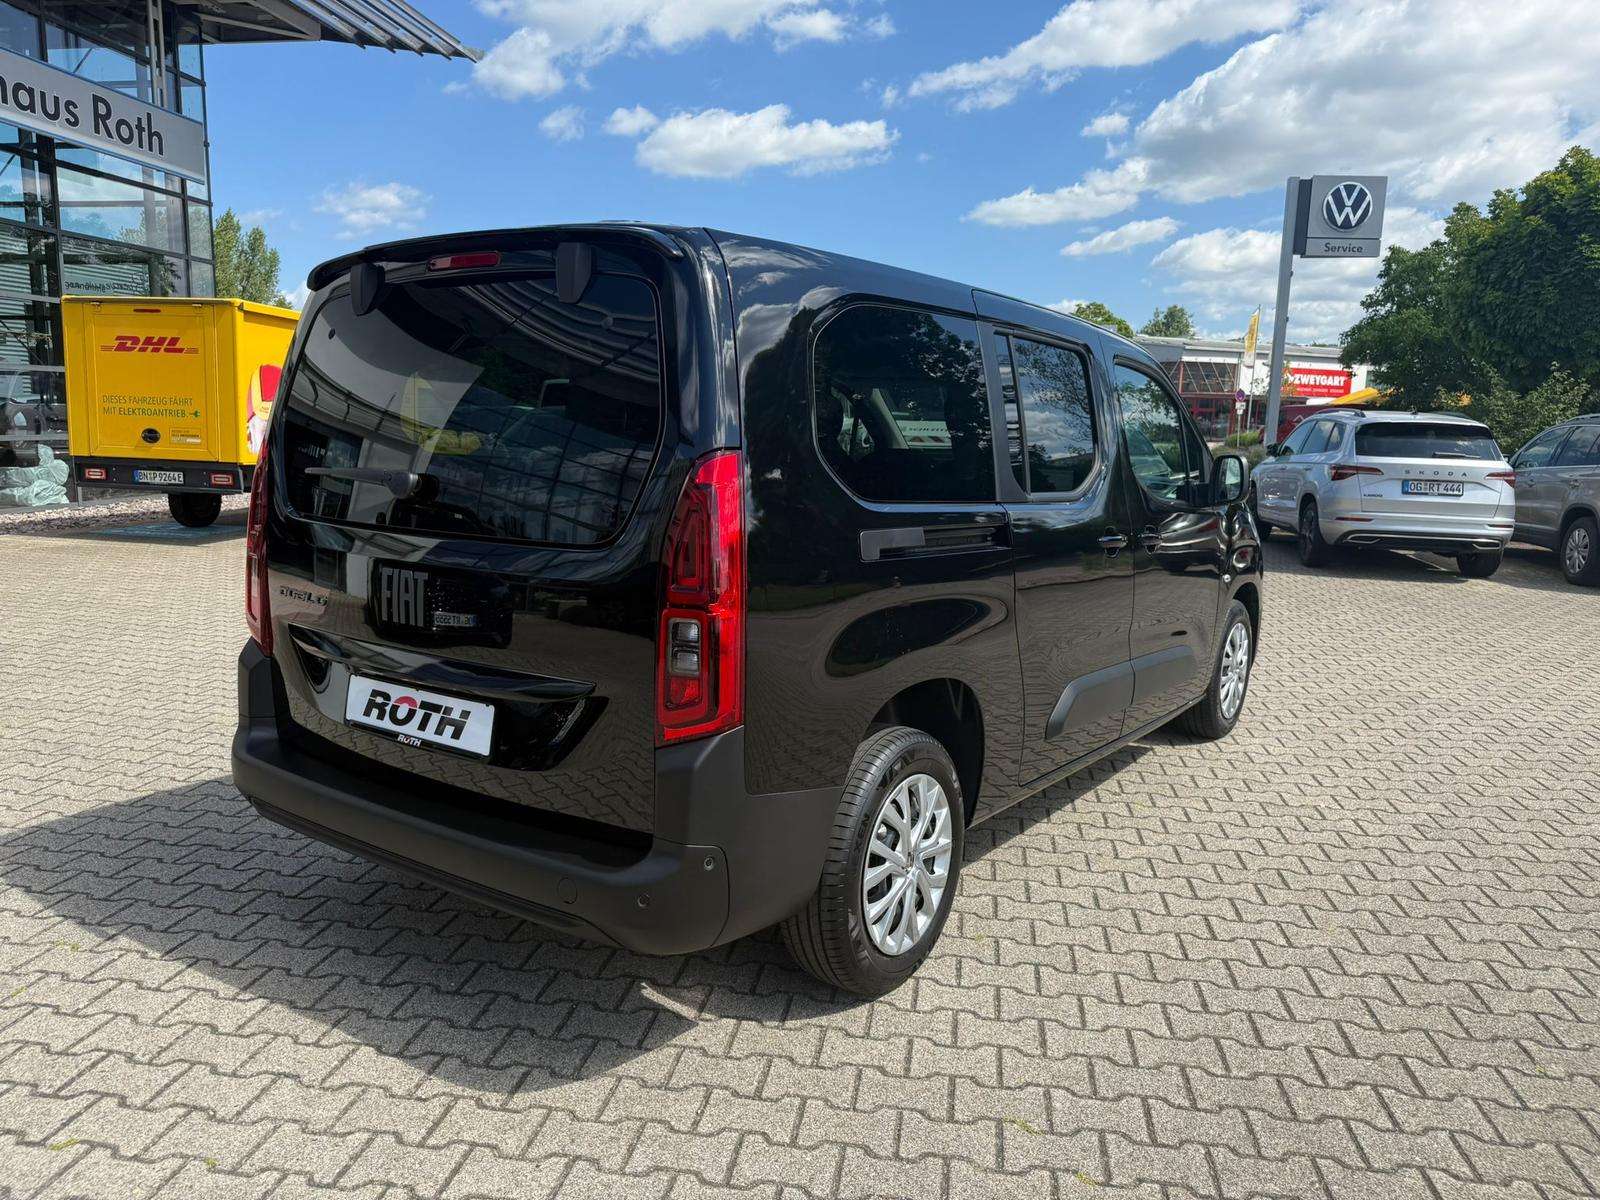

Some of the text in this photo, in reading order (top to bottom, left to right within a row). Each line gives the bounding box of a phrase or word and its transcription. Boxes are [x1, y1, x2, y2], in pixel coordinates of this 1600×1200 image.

[92, 93, 164, 156] Roth
[1324, 243, 1363, 253] Service
[113, 335, 186, 354] DHL
[1294, 374, 1345, 386] ZWEYGART
[102, 395, 193, 407] DIESES FAHRZEUG FÄHRT
[103, 407, 189, 418] MIT ELEKTROANTRIEB.
[1409, 482, 1462, 493] OG RT 444
[381, 566, 429, 627] FIAT
[362, 688, 472, 741] ROTH
[397, 734, 422, 747] ROTH
